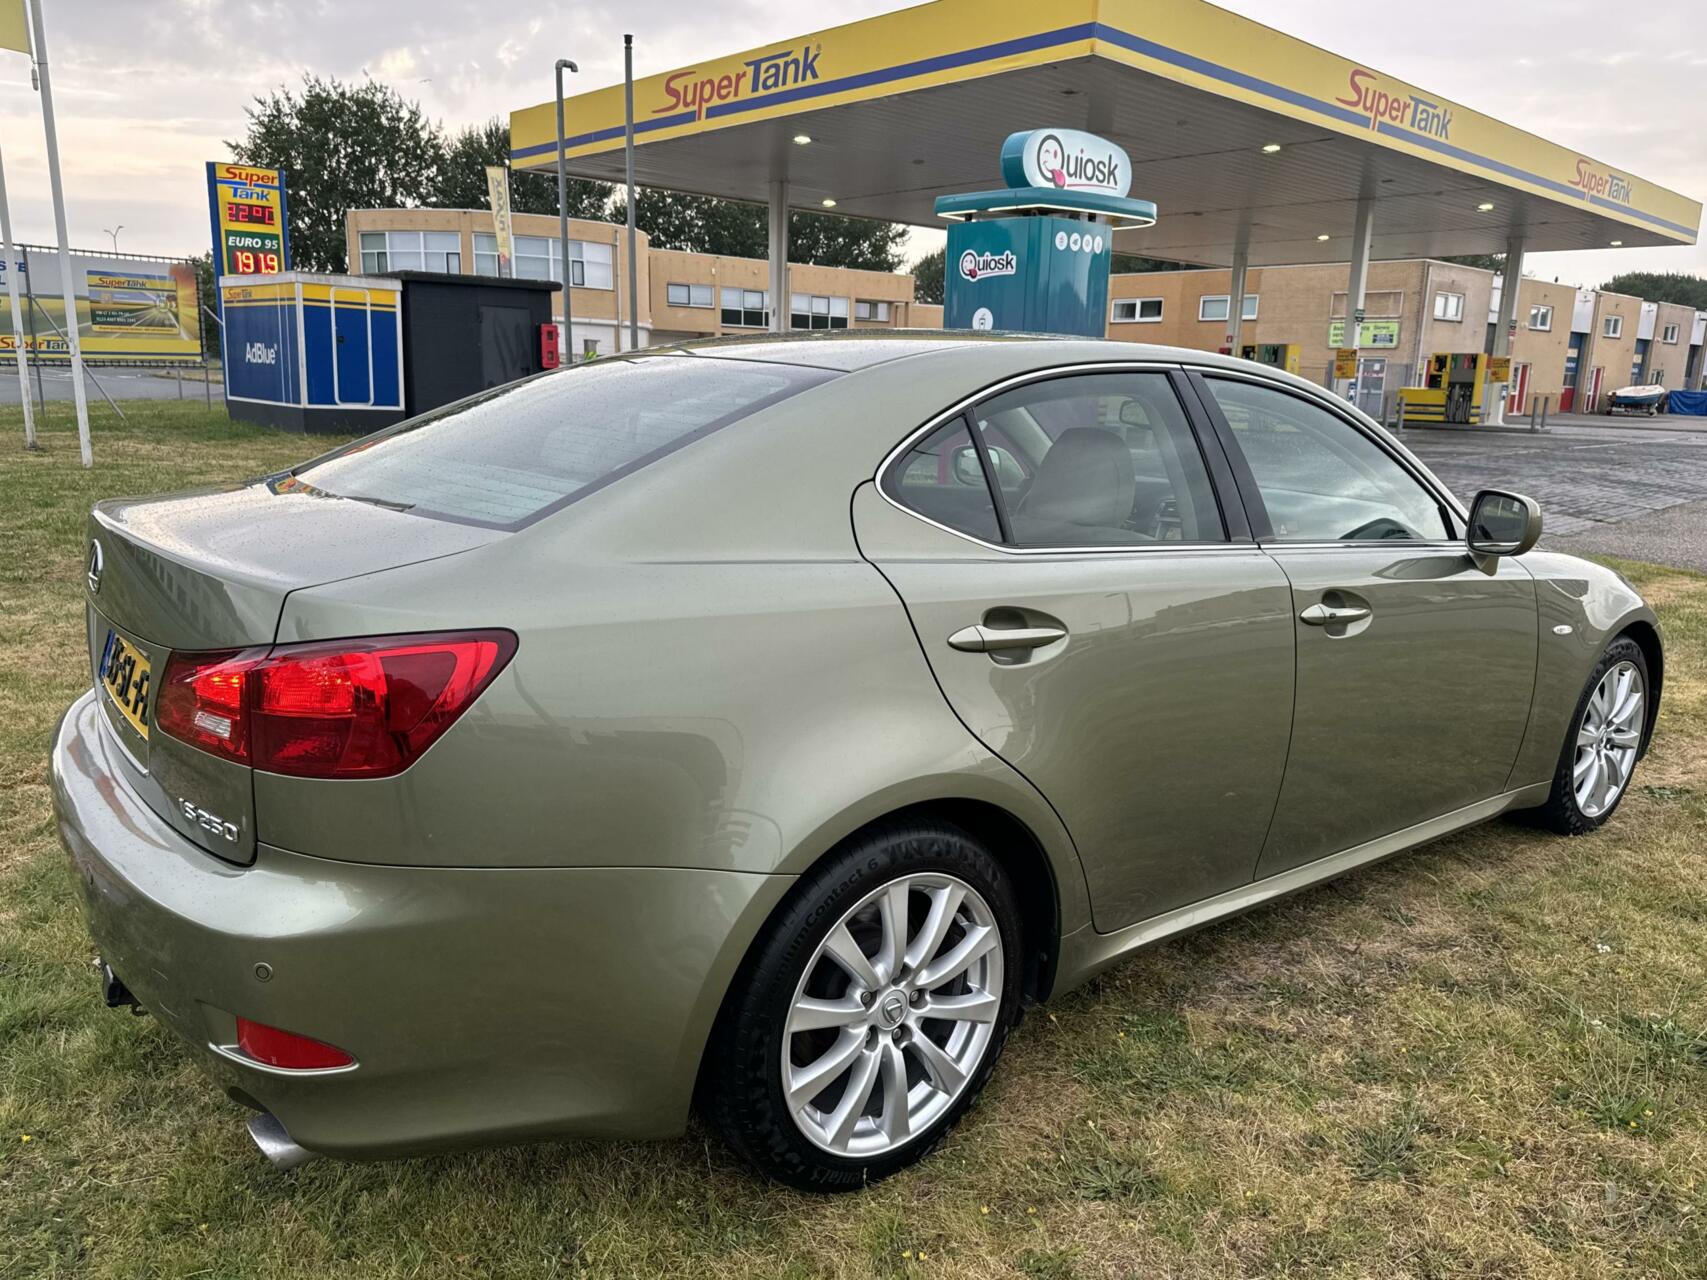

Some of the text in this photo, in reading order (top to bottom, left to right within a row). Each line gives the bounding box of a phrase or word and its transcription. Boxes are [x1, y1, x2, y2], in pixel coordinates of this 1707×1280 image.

[652, 46, 821, 121] SuperTank
[1335, 69, 1452, 140] SuperTank
[1037, 134, 1118, 188] Quiosk
[219, 166, 278, 187] Super
[1567, 158, 1632, 204] SuperTank
[227, 186, 270, 201] Tank
[228, 236, 278, 250] EURO 95
[961, 251, 1015, 279] Quiosk
[867, 857, 879, 871] 6
